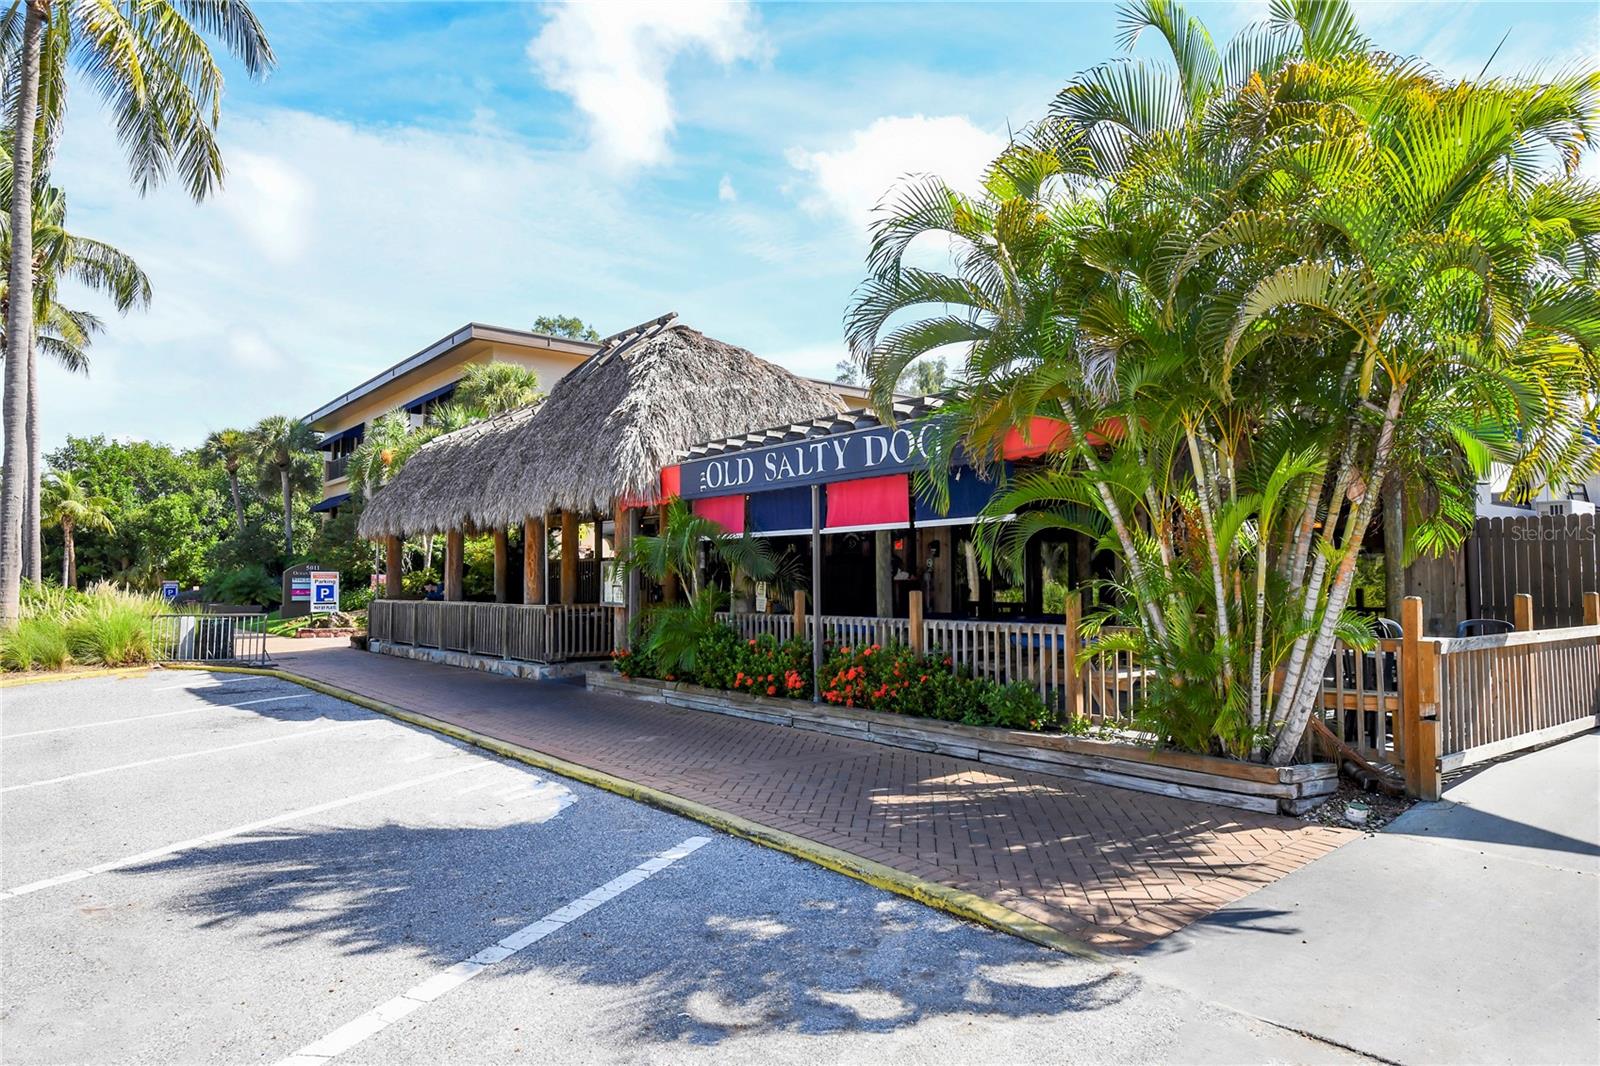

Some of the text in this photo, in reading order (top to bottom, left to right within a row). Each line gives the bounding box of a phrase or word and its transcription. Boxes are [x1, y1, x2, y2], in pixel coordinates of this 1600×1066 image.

[706, 457, 754, 488] OLD
[764, 437, 850, 482] SALTY
[320, 588, 329, 599] P
